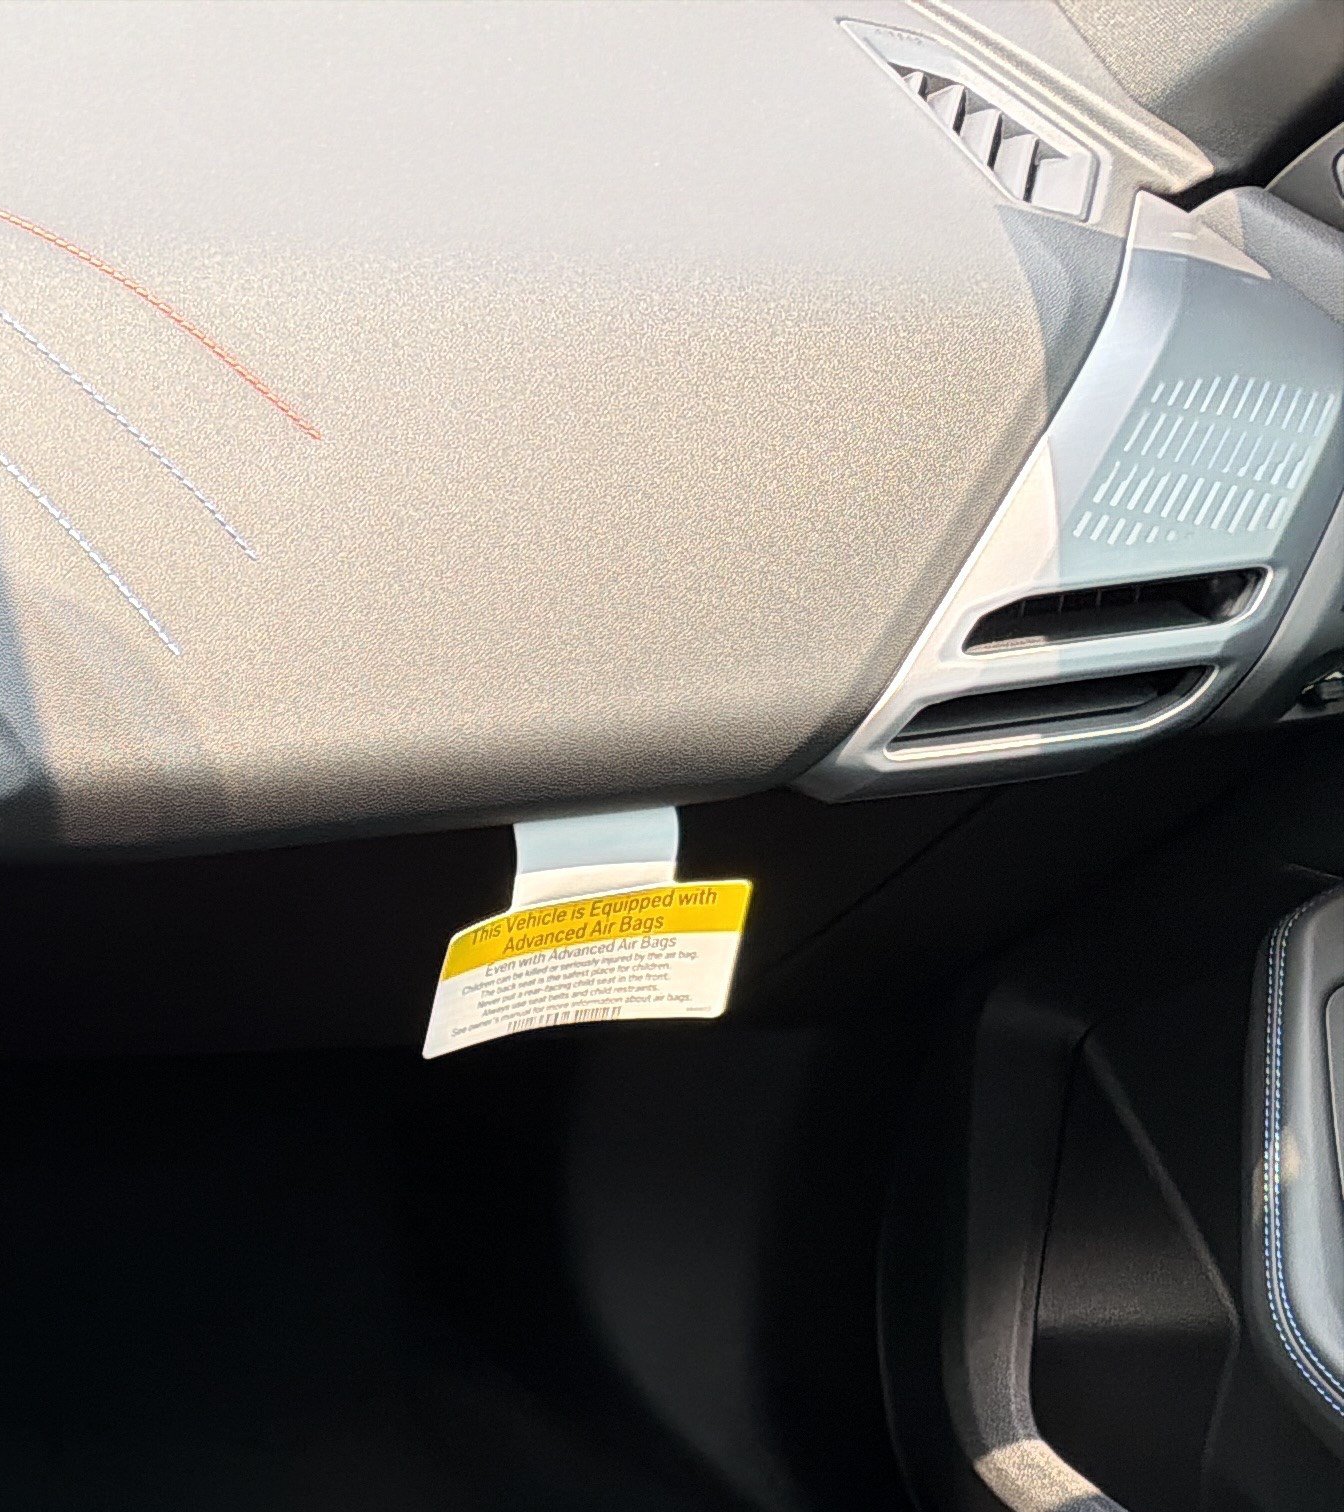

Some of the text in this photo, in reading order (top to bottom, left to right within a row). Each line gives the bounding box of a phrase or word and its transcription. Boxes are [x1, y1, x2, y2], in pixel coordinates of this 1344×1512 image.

[471, 887, 718, 946] This Vehicle is Equipped with
[502, 914, 665, 955] Advanced Air Bags
[485, 935, 677, 978] Even with Advanced Air Bags
